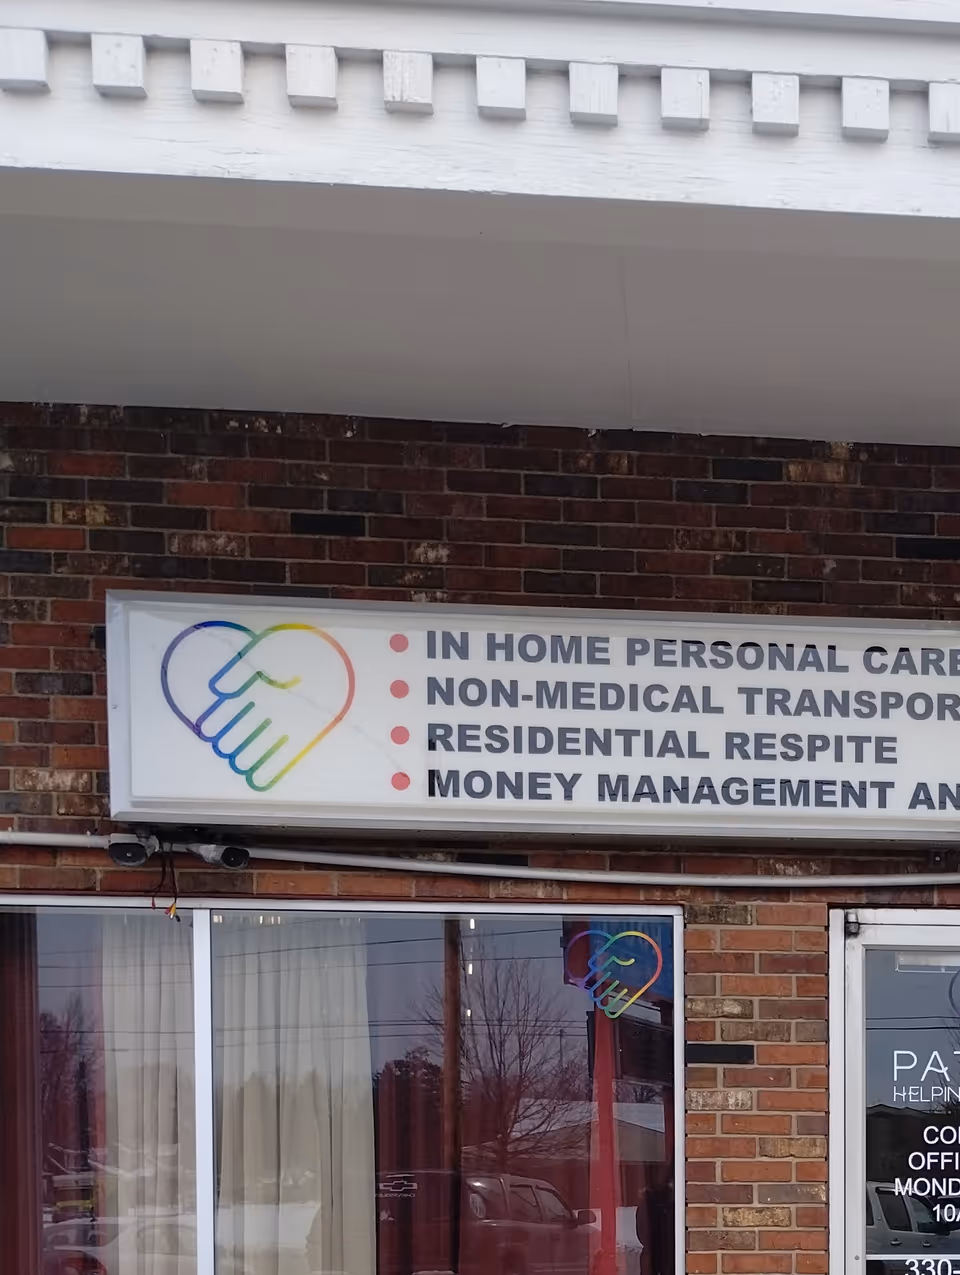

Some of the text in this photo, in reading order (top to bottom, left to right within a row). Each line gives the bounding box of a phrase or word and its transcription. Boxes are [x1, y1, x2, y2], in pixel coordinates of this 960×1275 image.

[427, 631, 469, 661] IN
[487, 632, 610, 665] HOME
[627, 638, 849, 673] PERSONAL
[427, 677, 724, 714] NON-MEDICAL
[427, 724, 898, 764] RESIDENTIAL RESPITE
[427, 769, 582, 800] MONEY
[599, 774, 894, 810] MANAGEMENT
